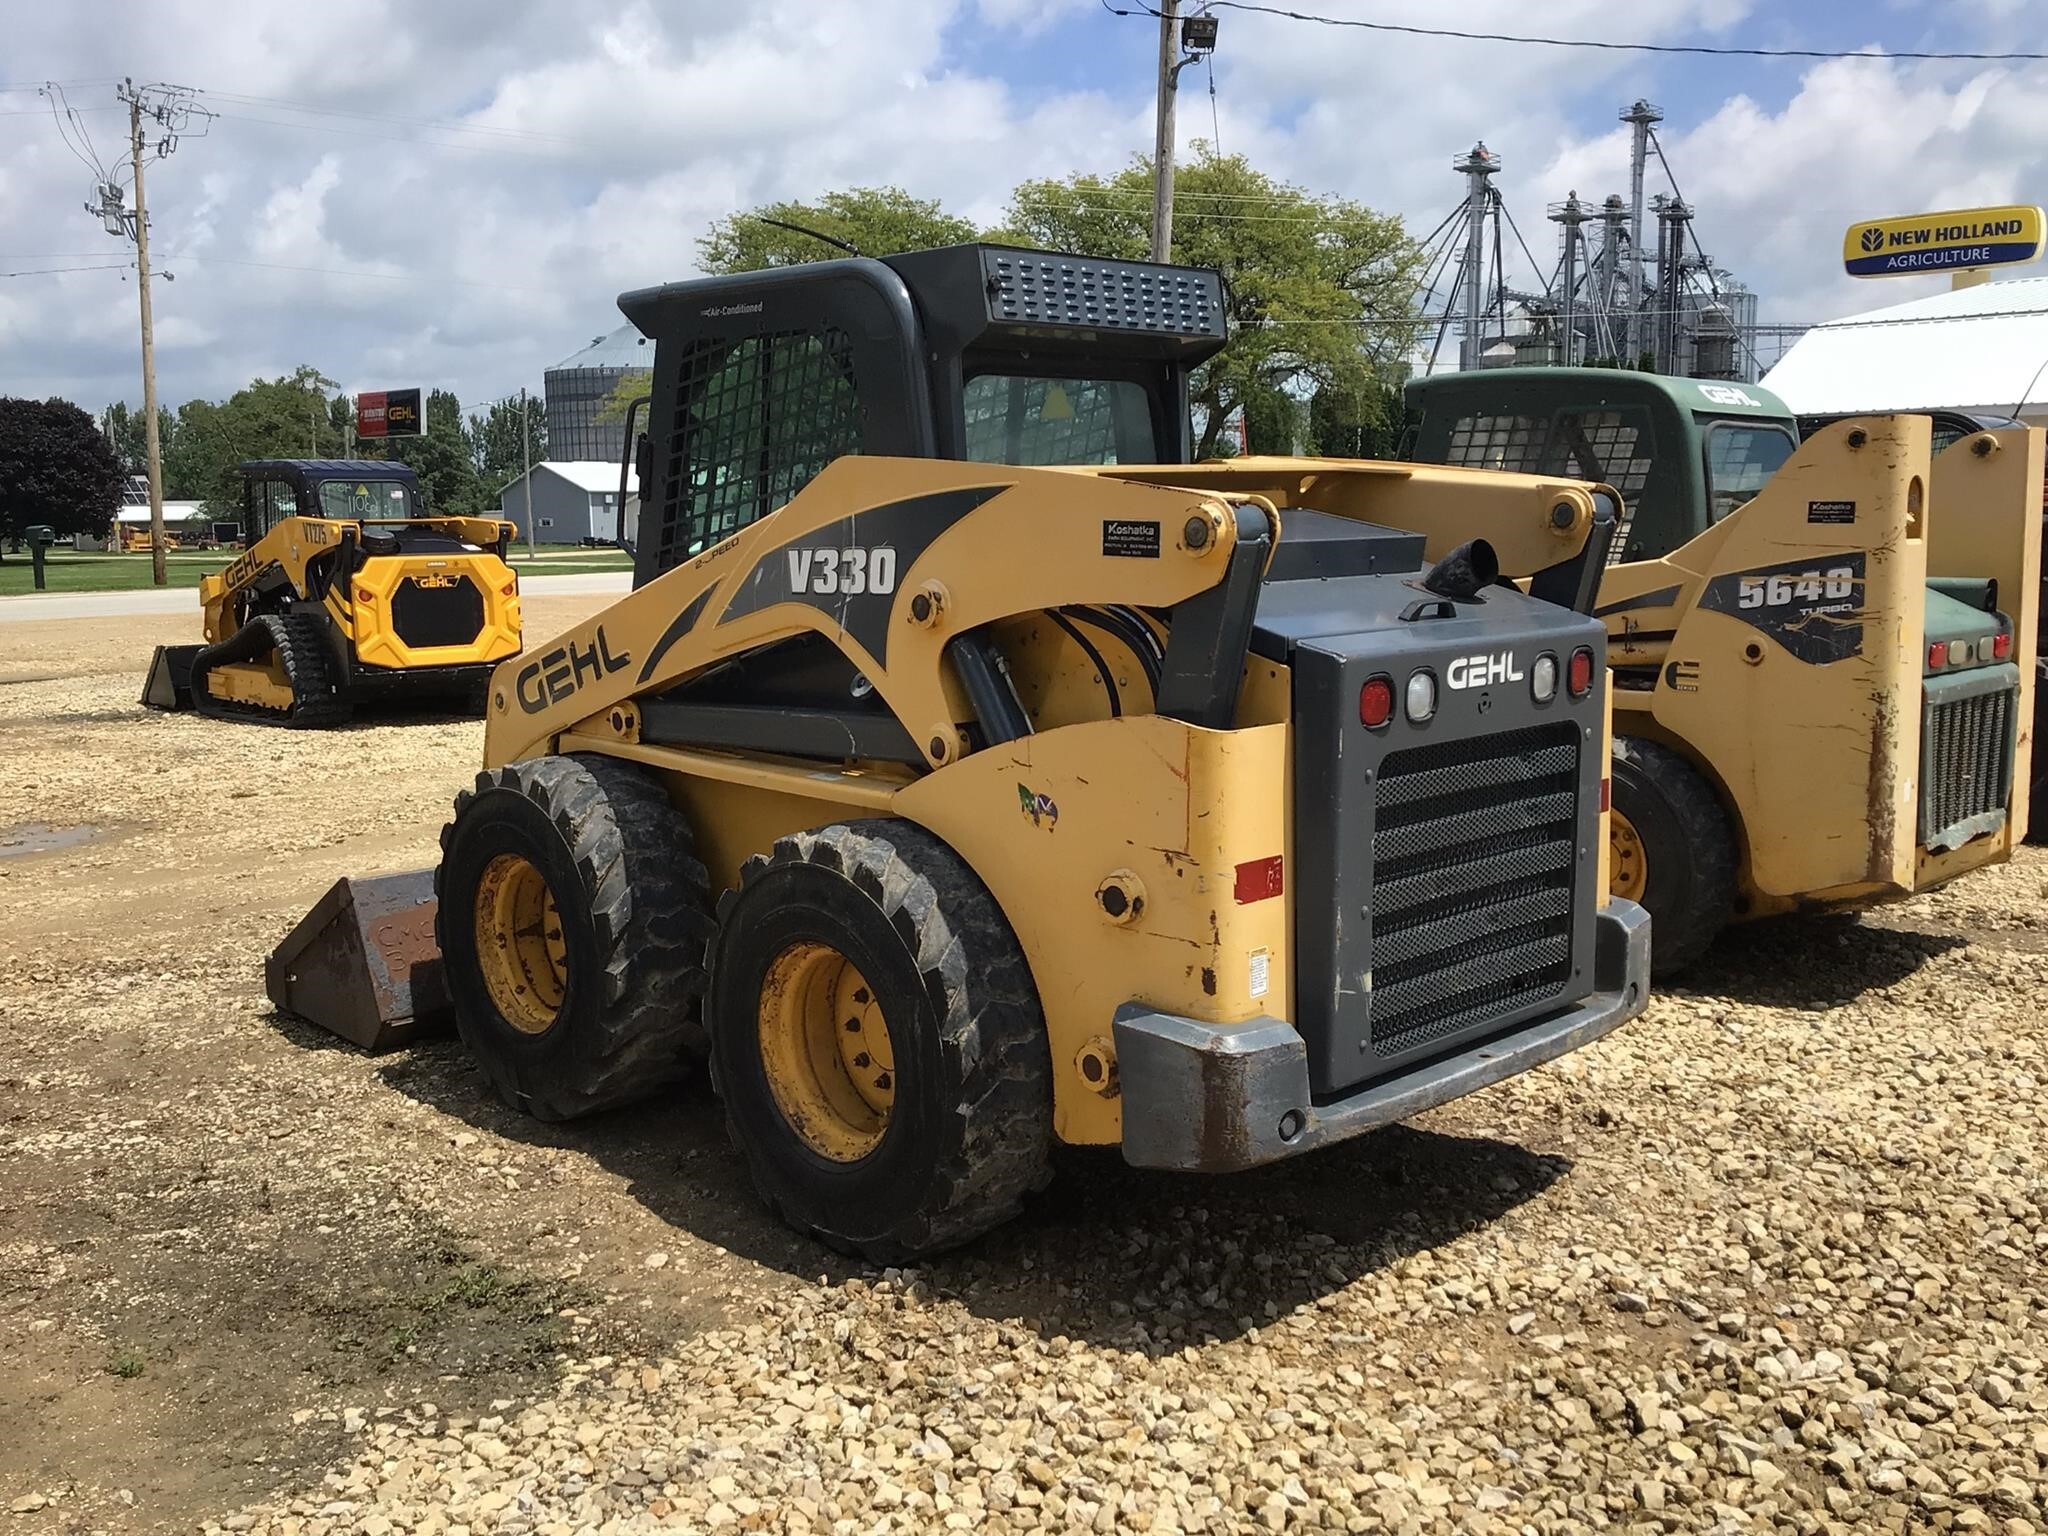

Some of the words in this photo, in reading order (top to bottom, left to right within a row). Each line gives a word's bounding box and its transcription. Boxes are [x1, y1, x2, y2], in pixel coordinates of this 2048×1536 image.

[1889, 229, 1930, 247] NEW
[1936, 219, 2023, 242] HOLLAND
[1887, 247, 1991, 268] AGRICULTURE
[1698, 385, 1762, 407] GEHL
[388, 405, 416, 420] GEHL
[303, 521, 327, 545] VT275
[1108, 522, 1155, 536] Koshatka
[225, 549, 263, 589] GEHL
[787, 548, 897, 594] V330
[420, 576, 453, 588] GEHL
[1739, 567, 1853, 609] 5640
[1800, 604, 1853, 616] TURBO
[516, 624, 631, 715] GEHL
[1446, 650, 1524, 690] GEHL
